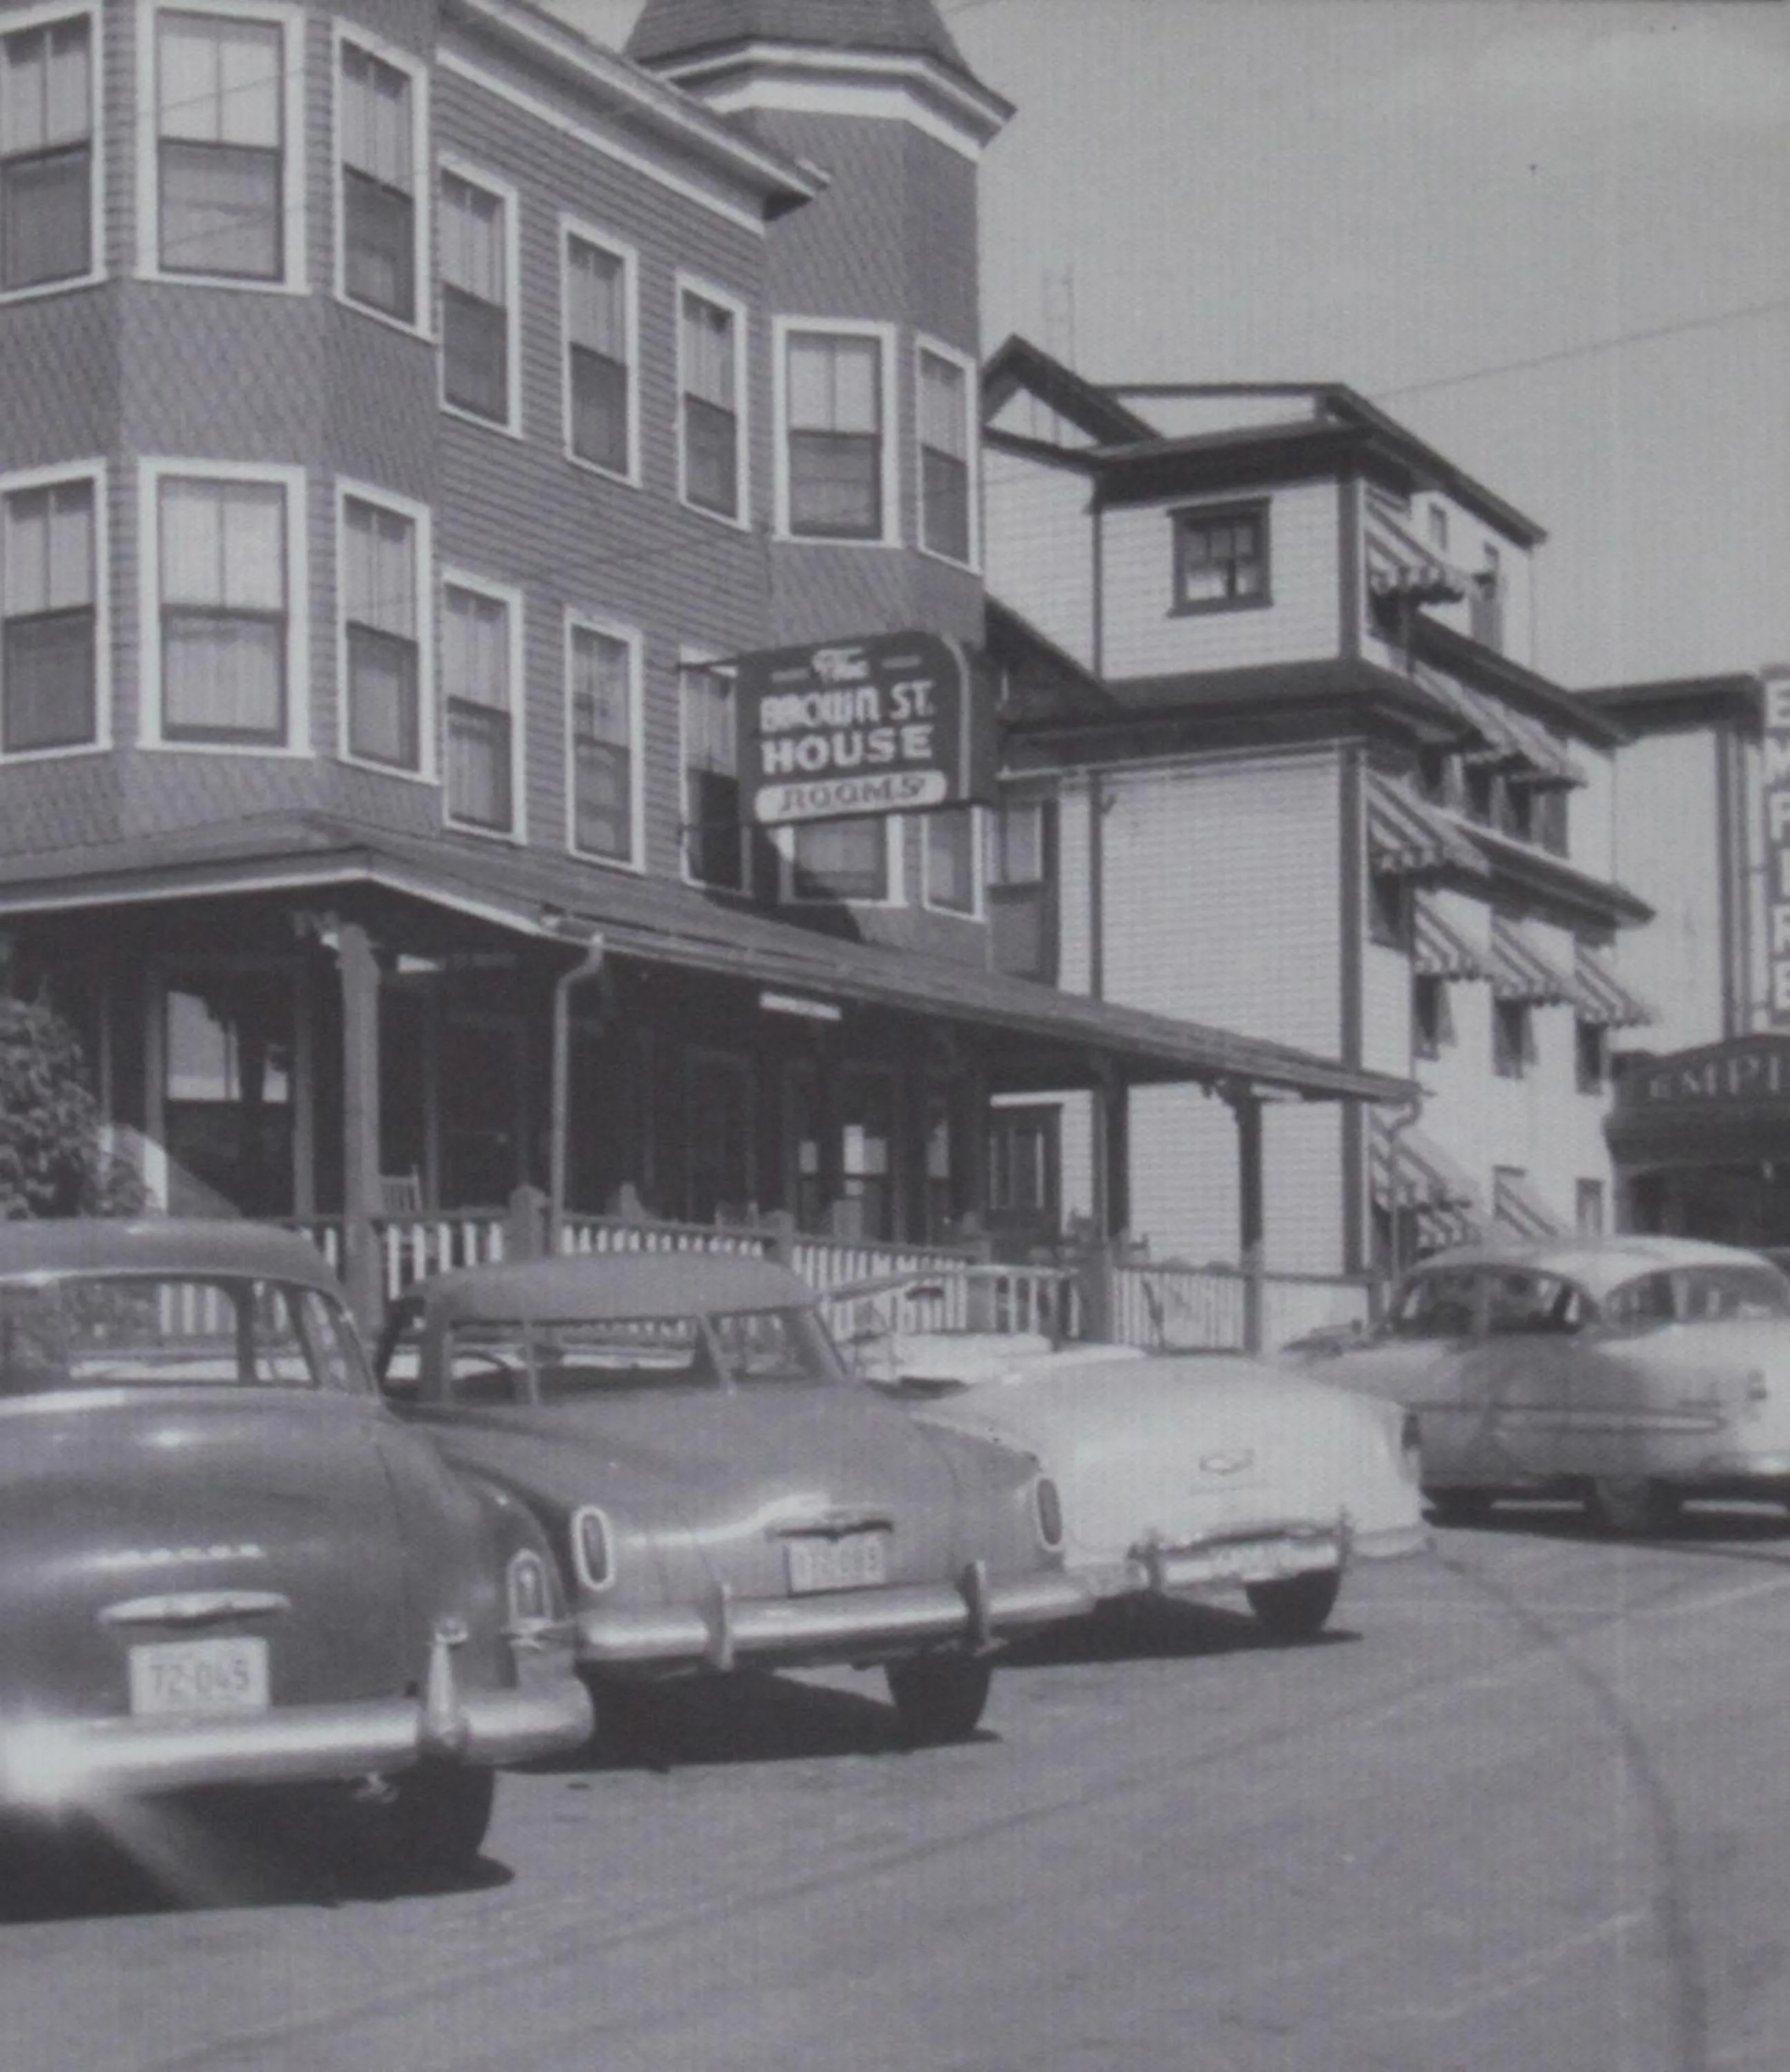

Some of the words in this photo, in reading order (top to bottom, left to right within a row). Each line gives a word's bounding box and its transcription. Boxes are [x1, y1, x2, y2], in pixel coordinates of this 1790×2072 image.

[760, 686, 880, 733] BROWN
[889, 679, 936, 720] ST.
[760, 724, 934, 776] HOUSE
[779, 775, 927, 813] ROOMS
